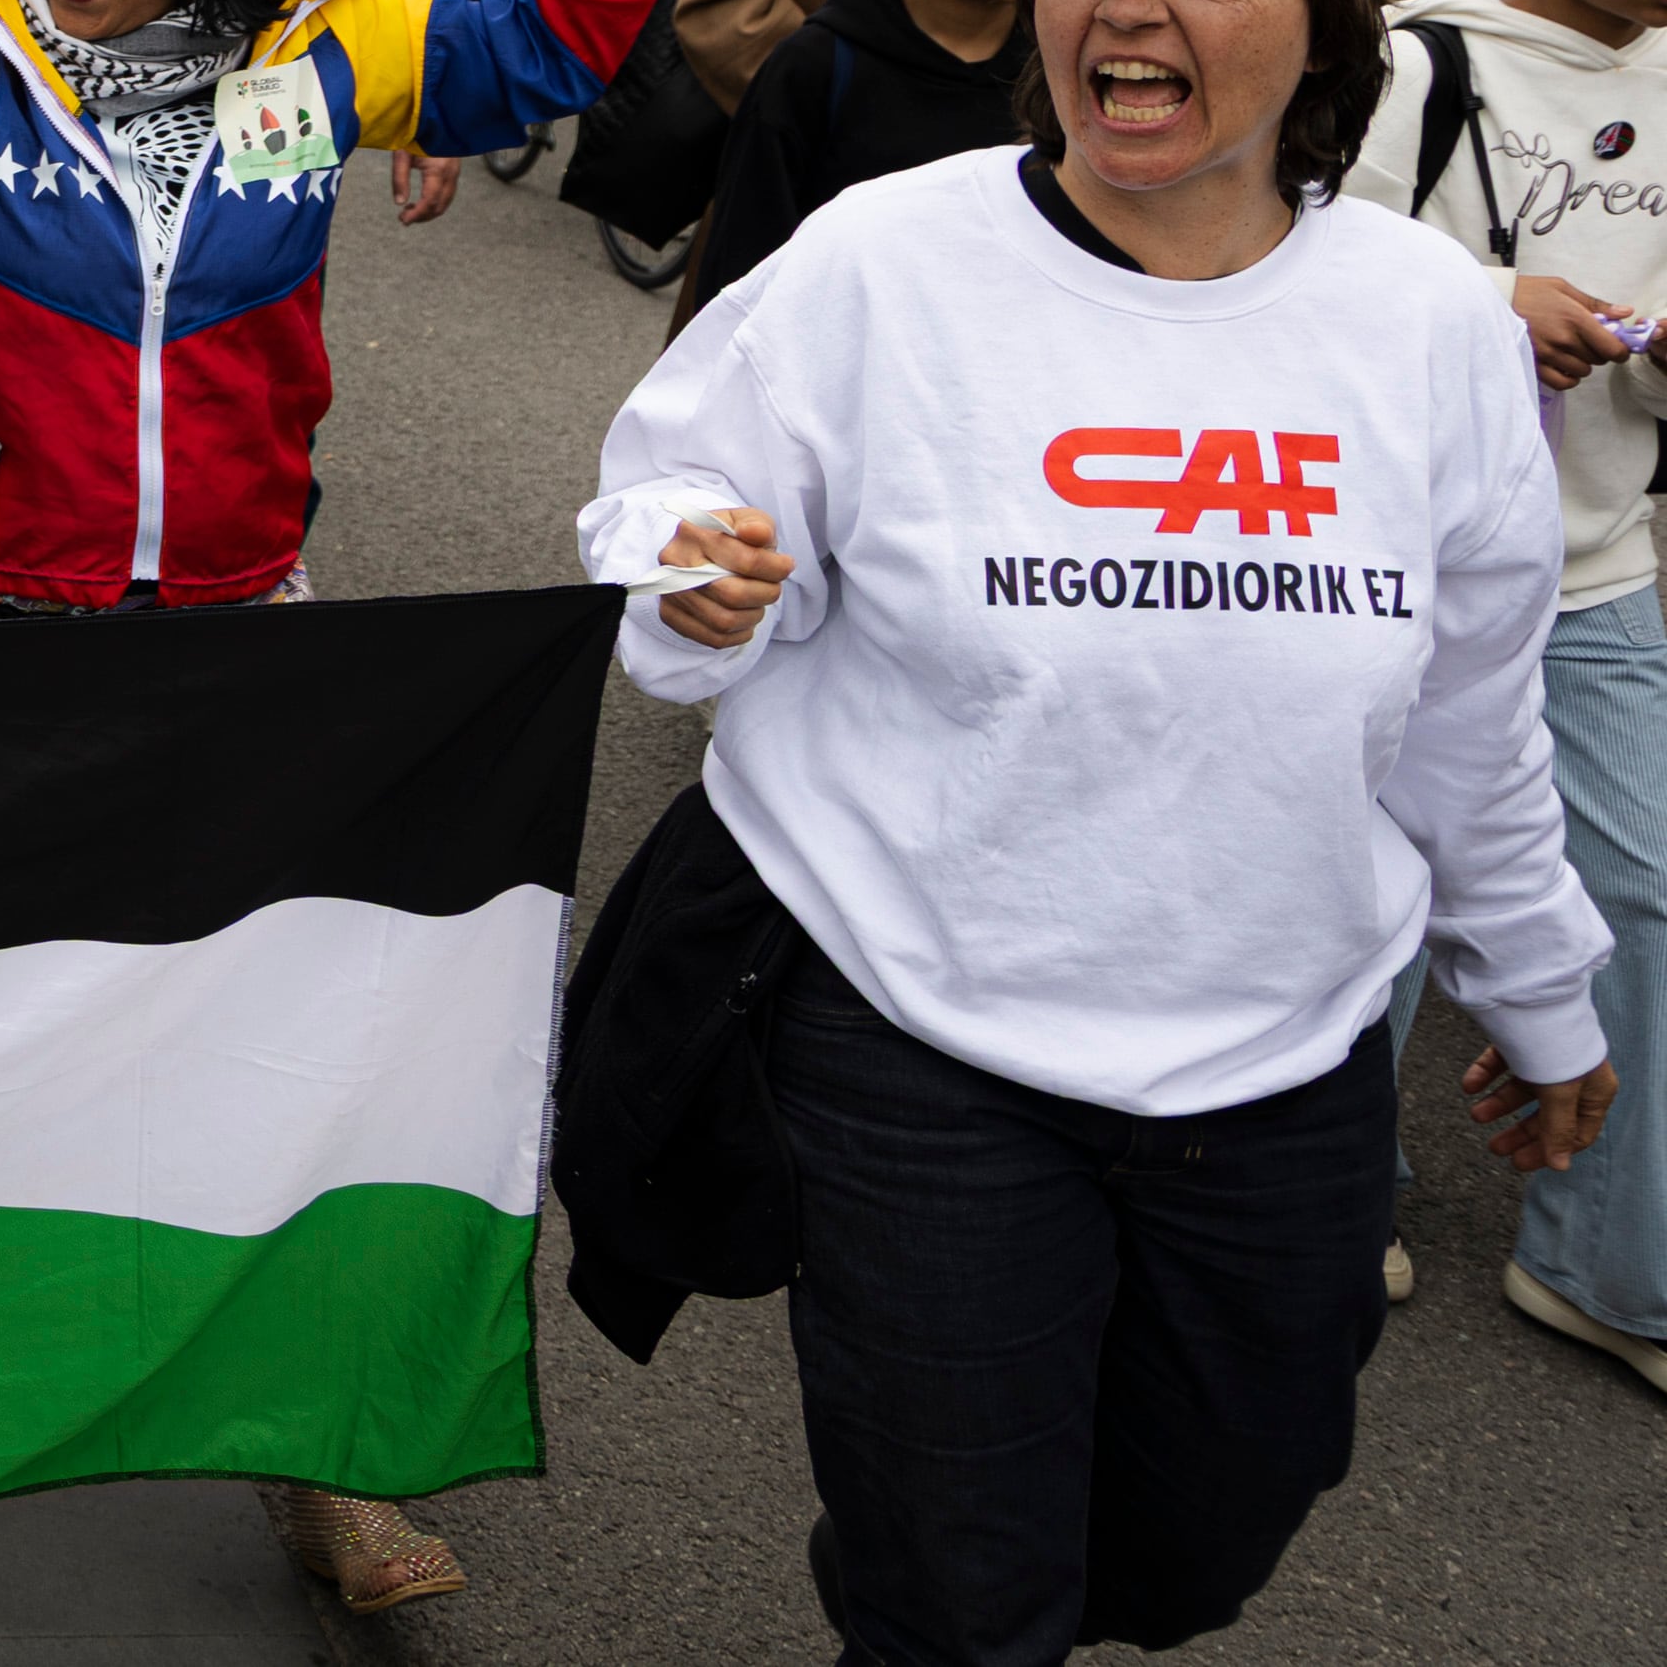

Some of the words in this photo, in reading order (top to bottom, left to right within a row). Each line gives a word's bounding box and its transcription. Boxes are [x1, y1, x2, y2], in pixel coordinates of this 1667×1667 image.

[1516, 159, 1667, 235] Drea
[1043, 427, 1340, 537] CAF
[984, 557, 1356, 615] NEGOZIDIORIK
[1362, 568, 1413, 619] EZ
